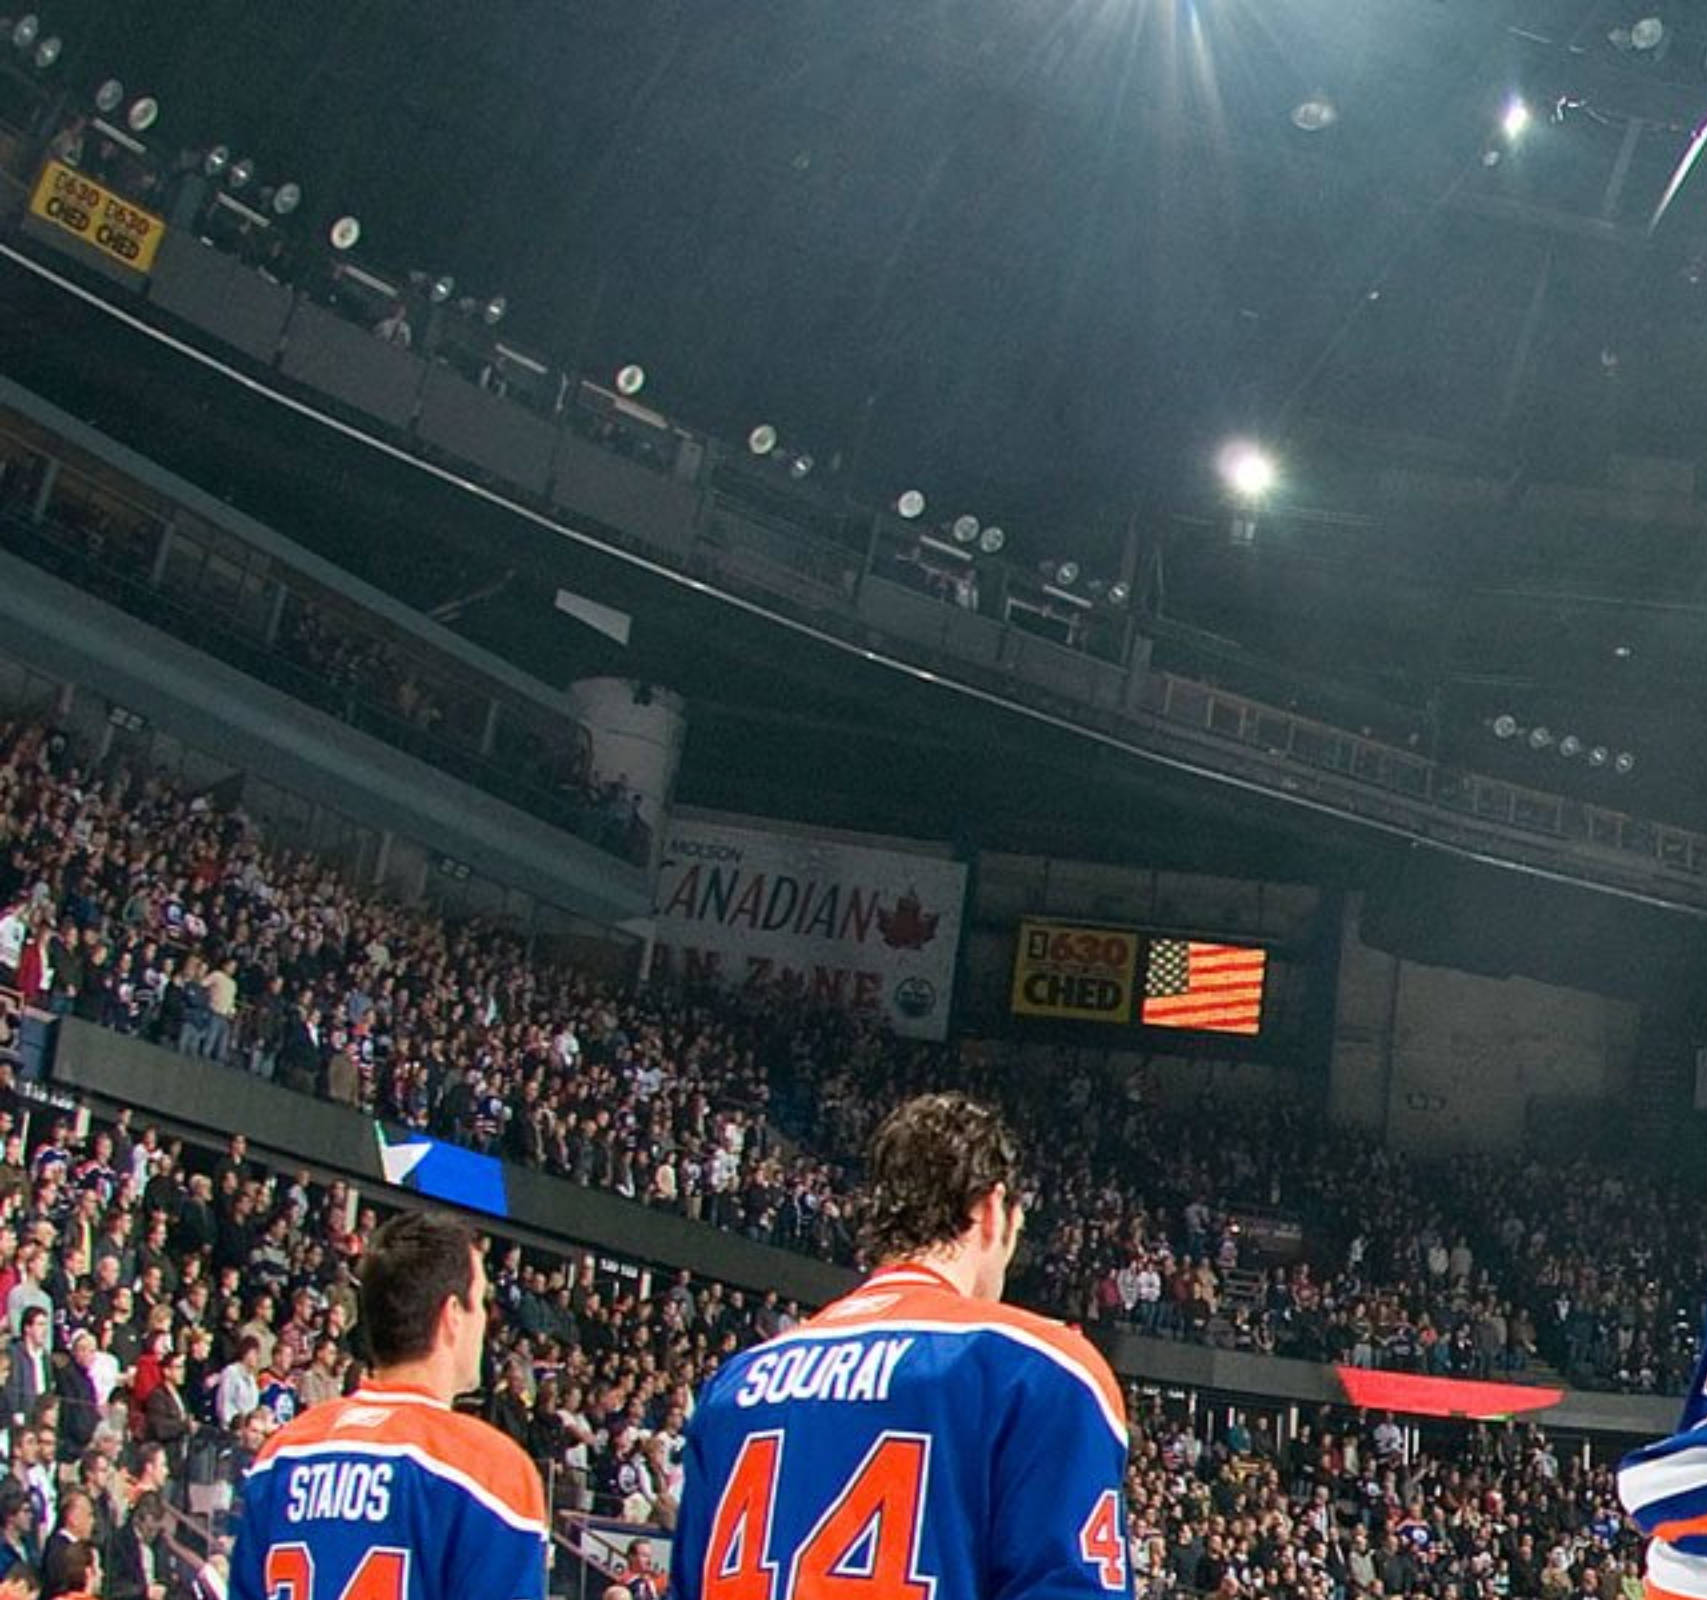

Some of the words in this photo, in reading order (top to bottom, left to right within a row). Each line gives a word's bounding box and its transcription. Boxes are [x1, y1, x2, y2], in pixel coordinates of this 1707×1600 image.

[1023, 972, 1123, 1012] CHED
[738, 1338, 913, 1407] SOURAY
[288, 1462, 393, 1522] STAIOS
[1080, 1489, 1127, 1590] 4
